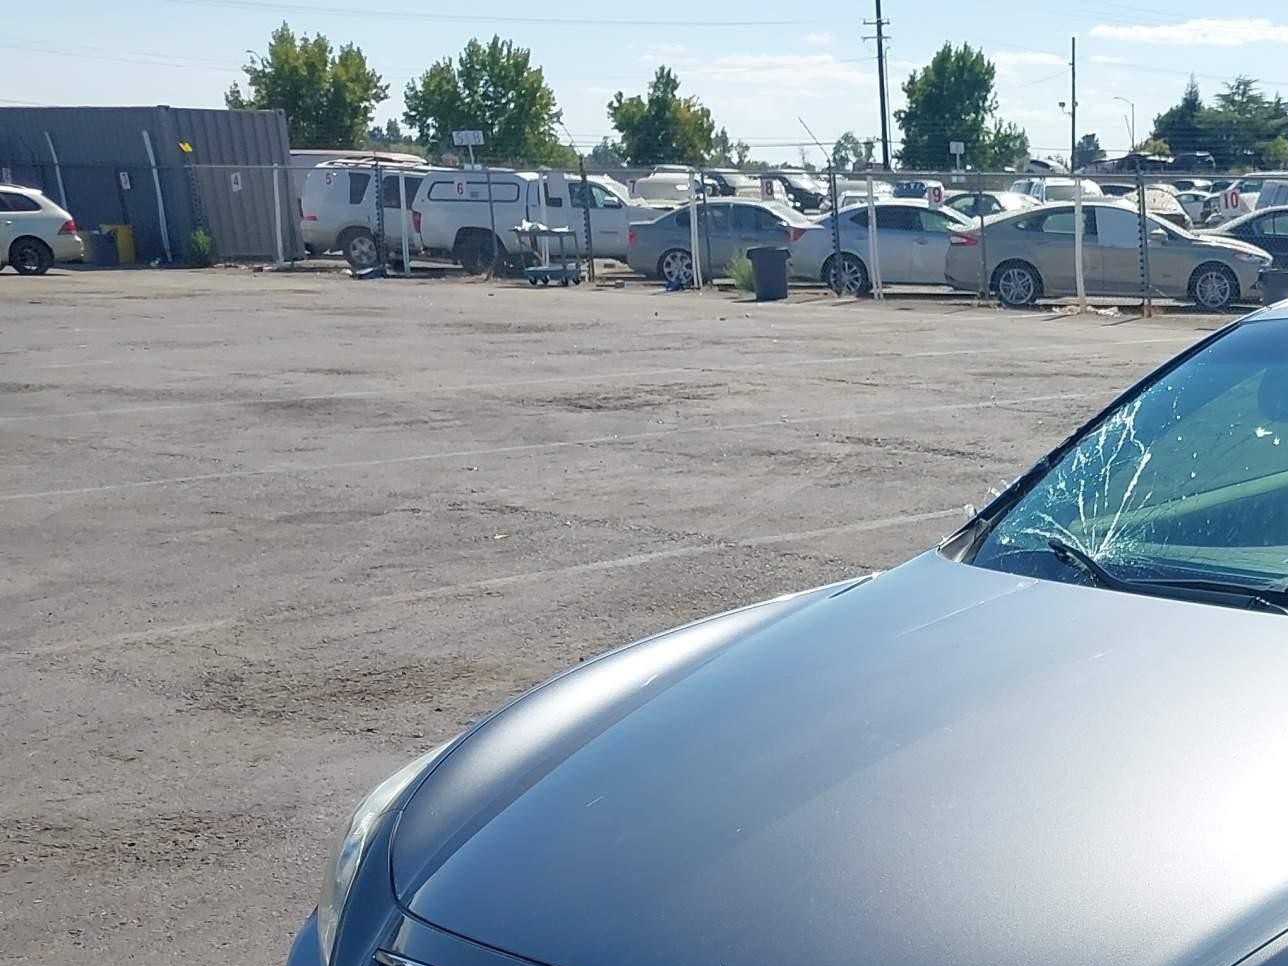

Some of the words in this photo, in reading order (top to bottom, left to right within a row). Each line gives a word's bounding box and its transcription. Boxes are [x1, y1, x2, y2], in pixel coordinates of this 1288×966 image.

[325, 172, 332, 185] 5
[457, 182, 464, 195] 6
[629, 180, 636, 193] 7
[765, 181, 773, 195] 8
[932, 186, 941, 203] 9
[1224, 191, 1239, 208] 10
